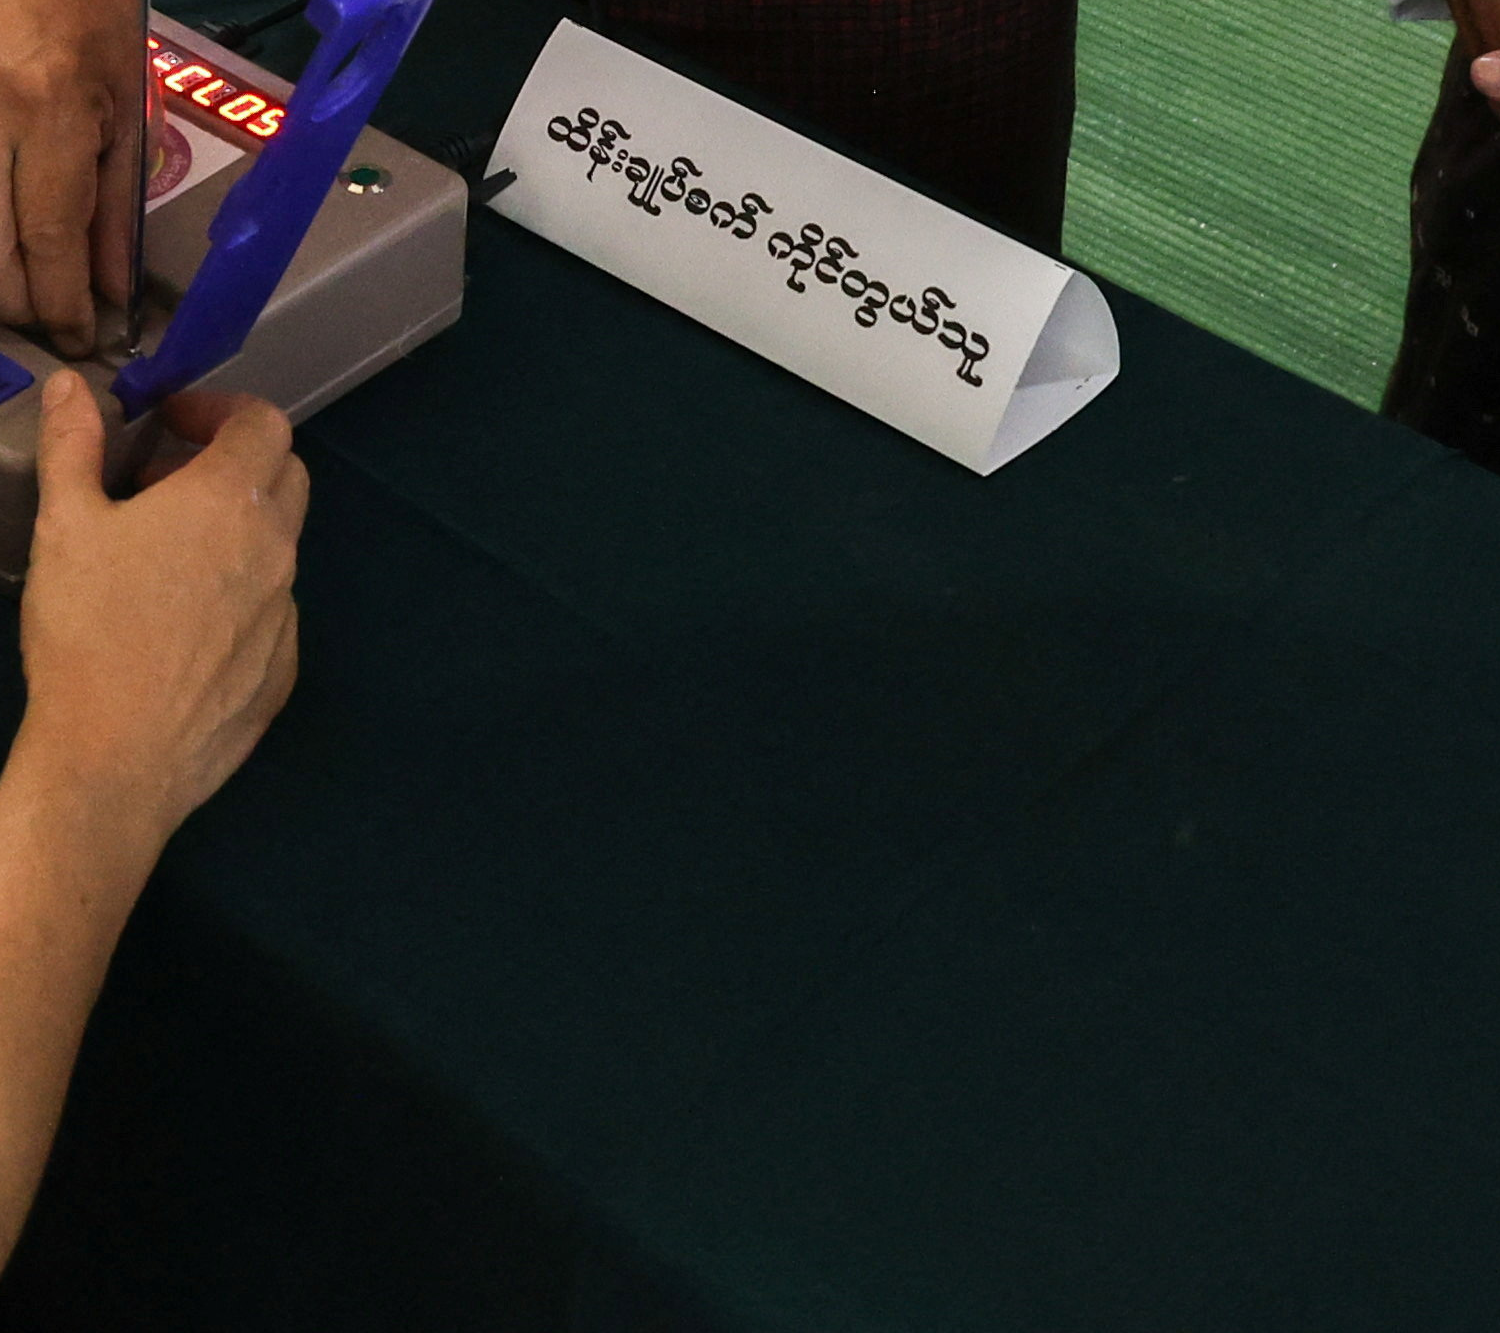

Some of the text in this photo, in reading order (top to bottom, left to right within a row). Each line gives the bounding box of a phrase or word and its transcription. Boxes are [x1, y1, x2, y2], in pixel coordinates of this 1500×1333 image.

[546, 106, 990, 388] ထိန်းချုပ်စက် ကိုင်တွယ်သူ
